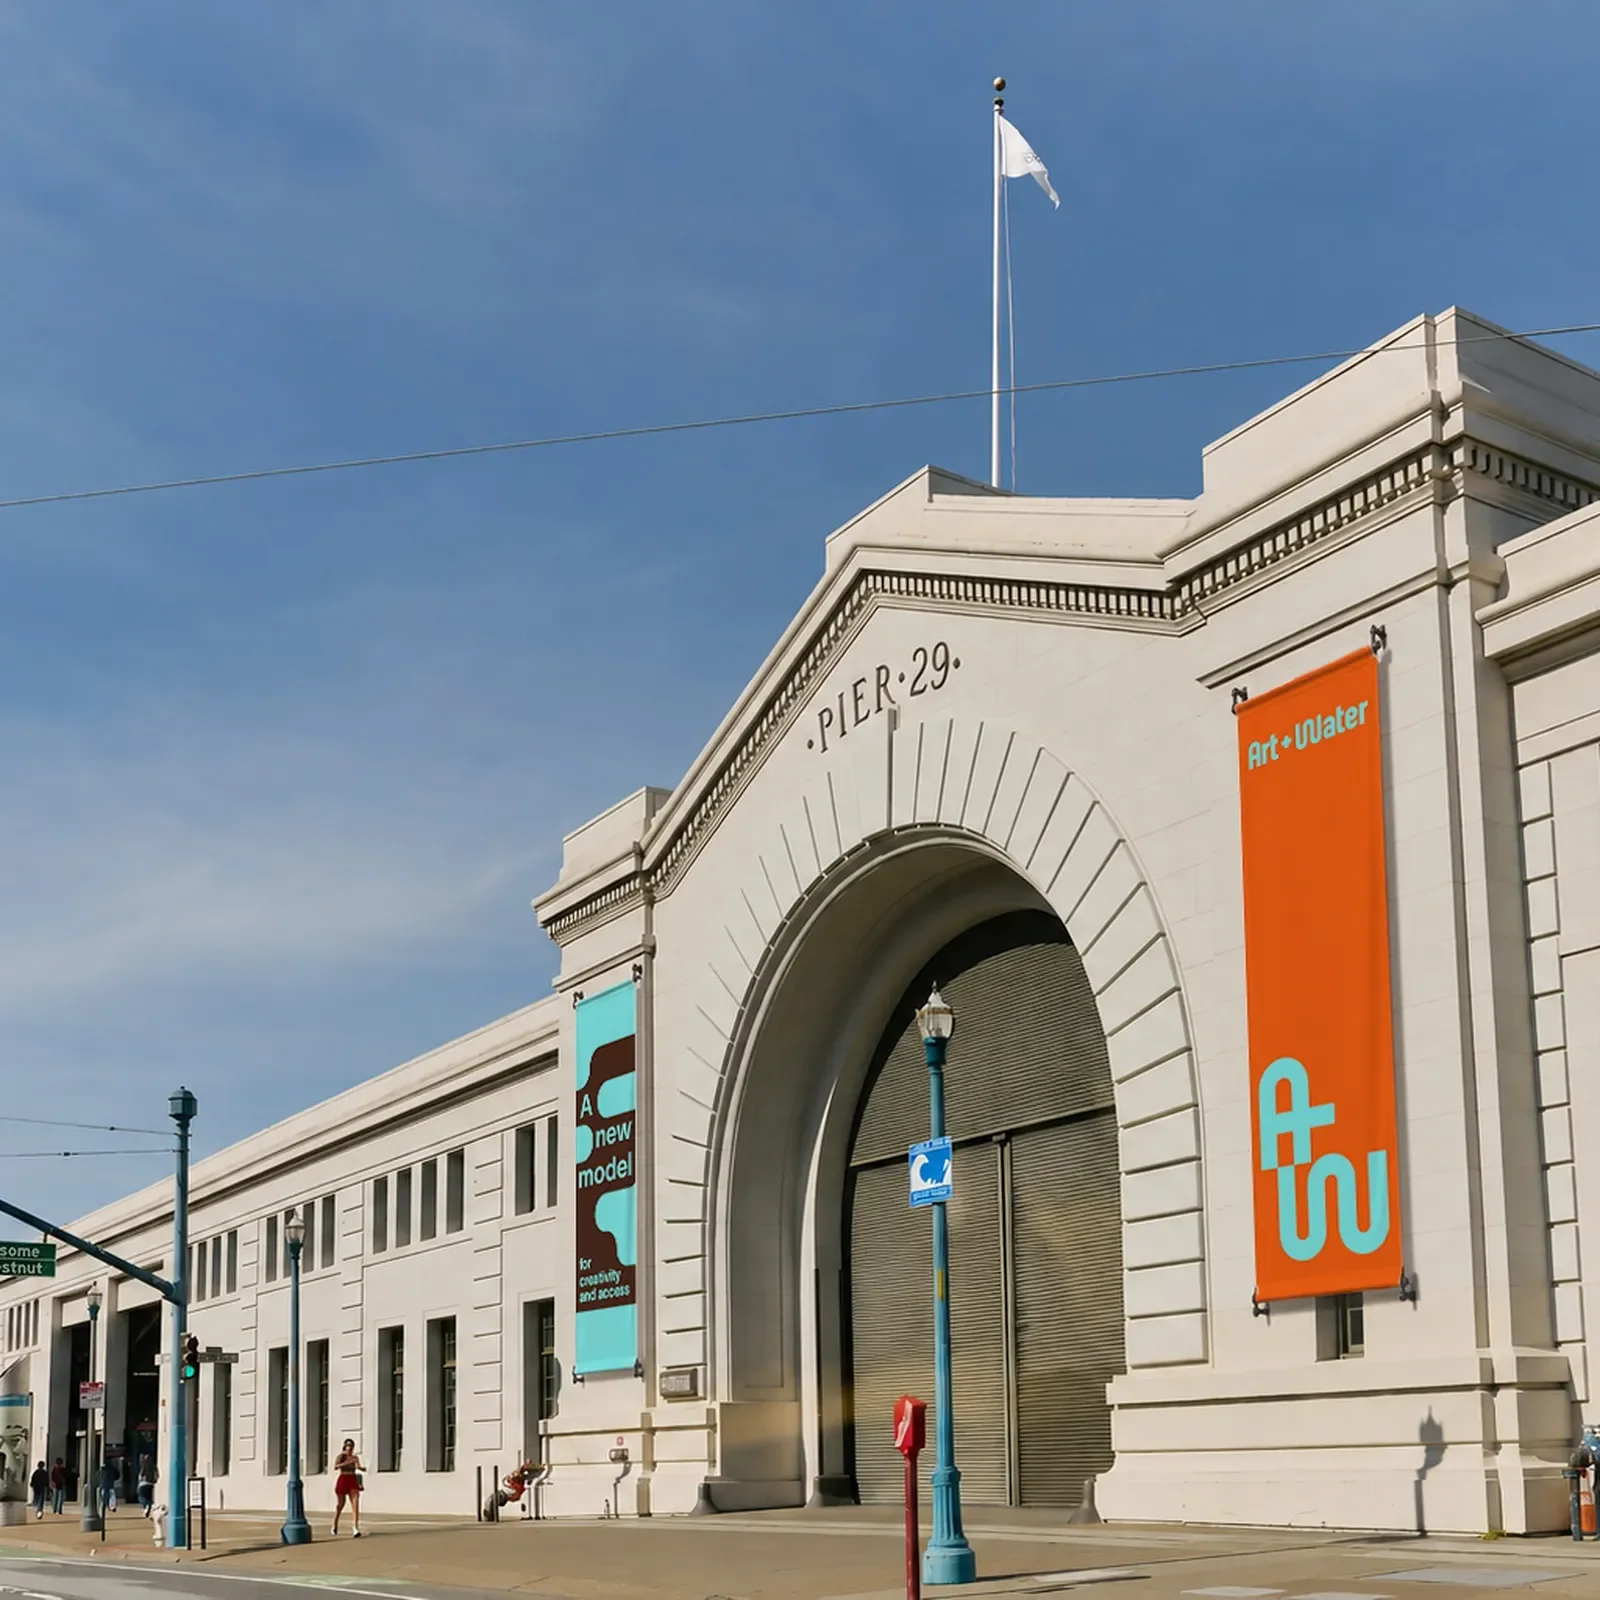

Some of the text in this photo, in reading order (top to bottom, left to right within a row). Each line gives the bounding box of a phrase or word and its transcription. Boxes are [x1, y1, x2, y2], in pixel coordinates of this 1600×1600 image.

[818, 641, 950, 754] PIER 29
[1248, 734, 1279, 770] Art
[1295, 700, 1368, 750] Water
[580, 1094, 593, 1119] A
[595, 1121, 633, 1148] new
[578, 1151, 633, 1189] model
[0, 1246, 40, 1258] some
[0, 1261, 43, 1274] stnut
[579, 1257, 592, 1270] for
[579, 1269, 622, 1288] creativity
[579, 1284, 631, 1303] and access
